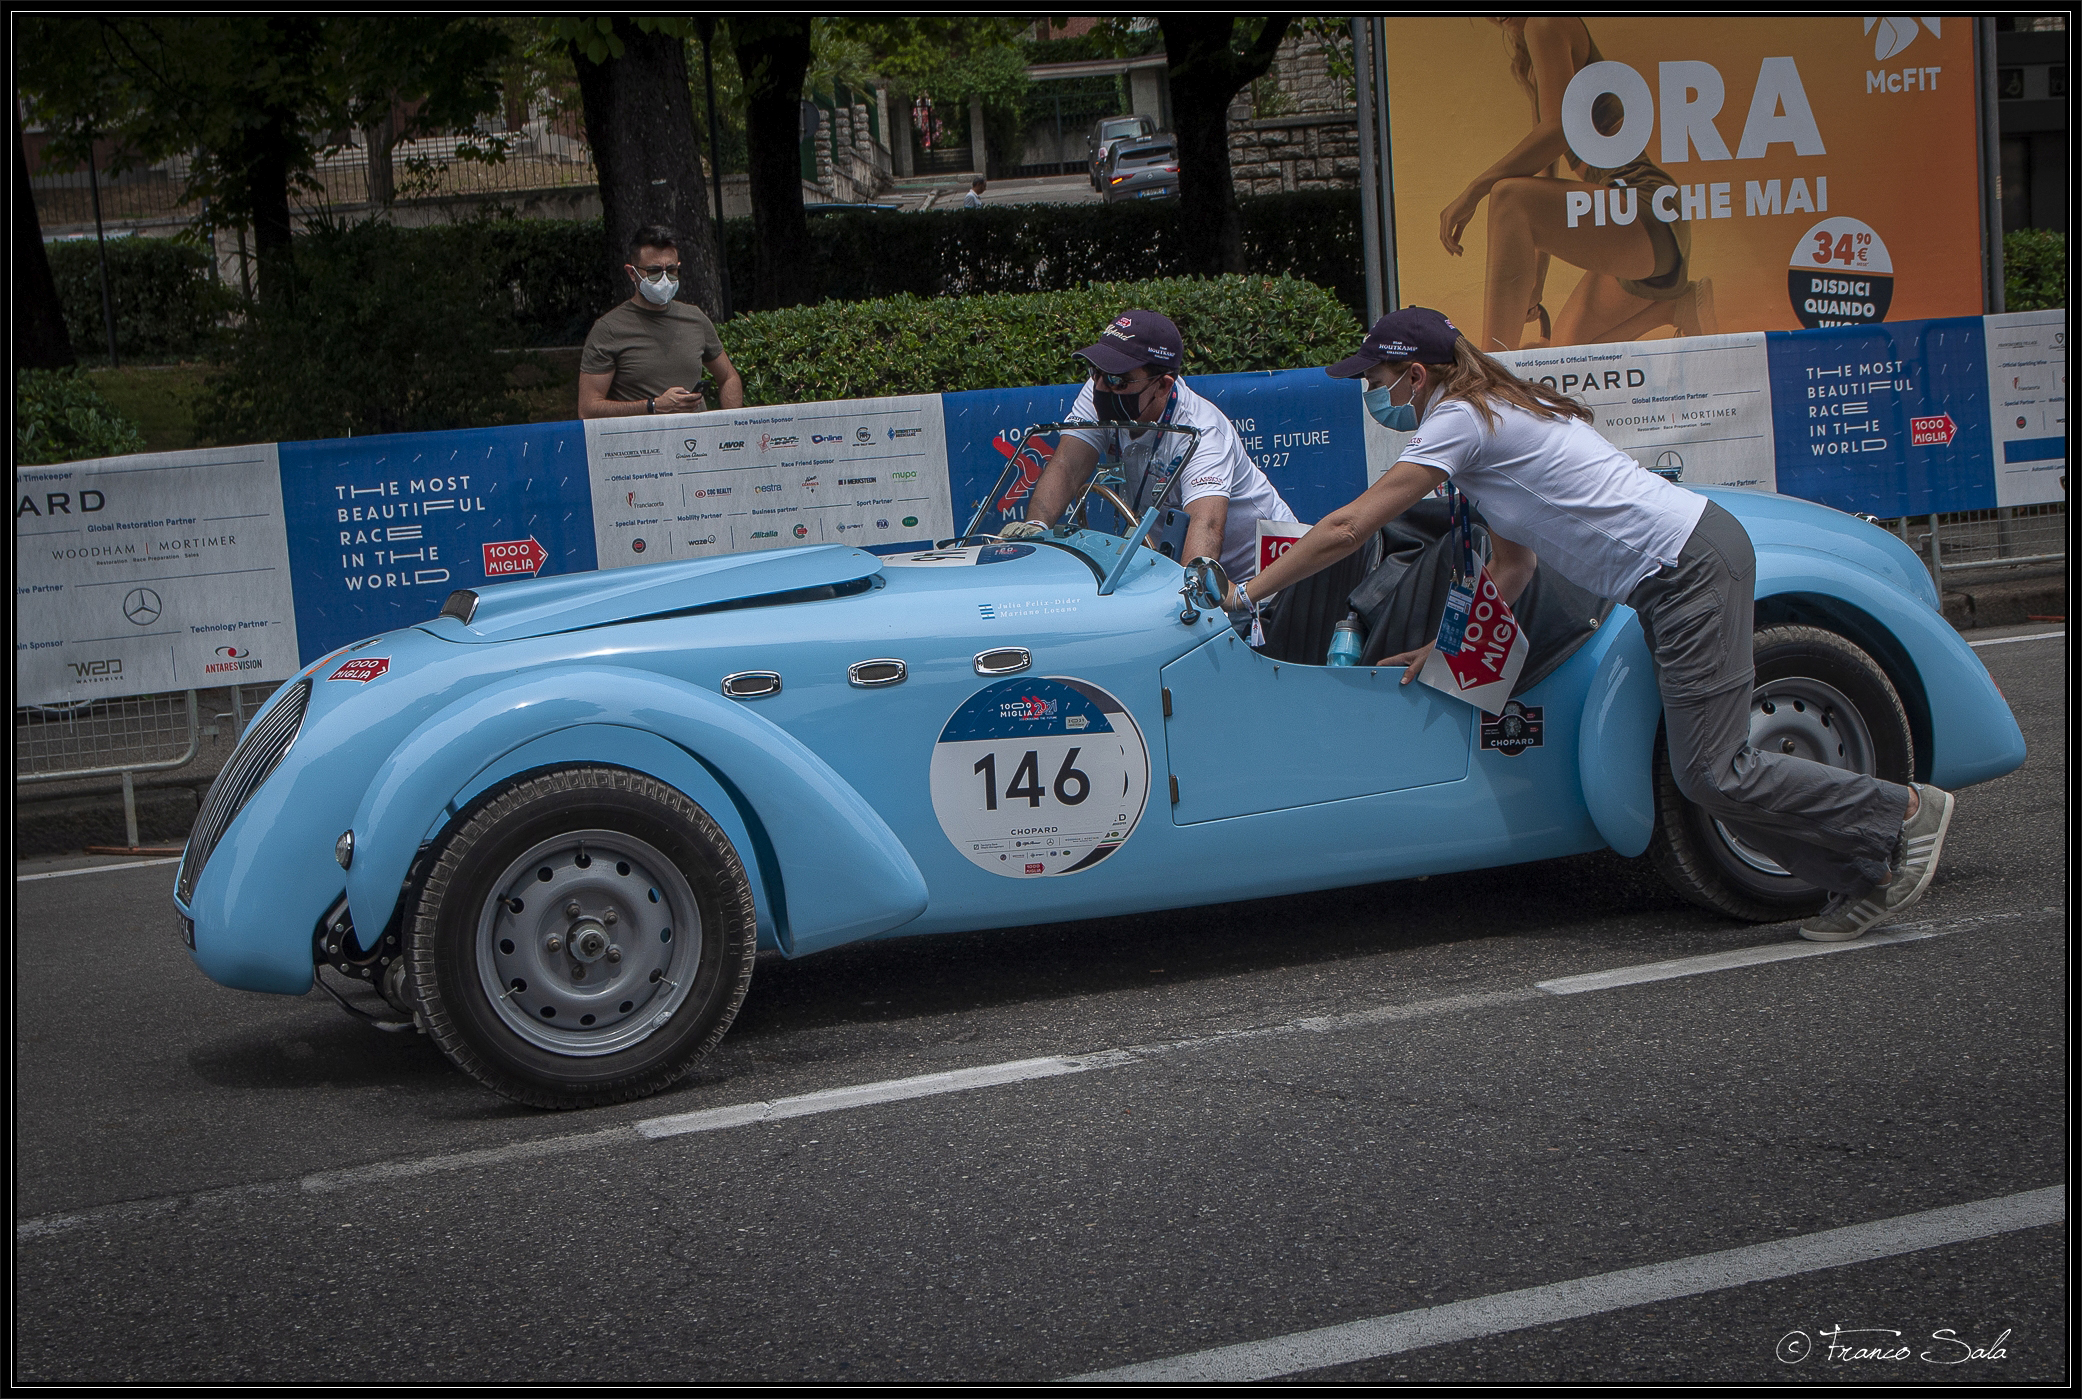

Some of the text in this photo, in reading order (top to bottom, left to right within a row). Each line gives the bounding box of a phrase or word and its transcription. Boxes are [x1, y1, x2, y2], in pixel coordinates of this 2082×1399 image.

[1867, 67, 1941, 94] McFIT
[1561, 56, 1826, 168] ORA
[1566, 176, 1828, 228] PIÙ CHE MAI
[1812, 231, 1855, 266] 34
[1856, 232, 1872, 245] 90
[1811, 278, 1870, 297] DISDICI
[1804, 298, 1875, 318] QUANDO
[1379, 343, 1418, 352] HOUTKAMP
[1534, 359, 1559, 367] Sponsor
[1566, 356, 1587, 364] Official
[1588, 354, 1623, 362] Timekeeper
[1806, 360, 1903, 380] THE MOST
[1807, 379, 1914, 399] BEAUTIFUL
[1632, 392, 1709, 404] Global Restoration Partner
[1605, 407, 1737, 427] WOODHAM MORTIMER
[1809, 401, 1868, 418] RACE
[1810, 420, 1880, 438] IN THE
[1915, 419, 1944, 430] 1000
[719, 440, 745, 449] LAVOR
[1273, 430, 1330, 448] FUTURE
[1914, 431, 1947, 443] MIGLIA
[1811, 438, 1887, 456] WORLD
[1253, 452, 1290, 468] 1927
[23, 472, 72, 482] Timekeeper
[611, 473, 631, 482] Official
[632, 472, 658, 481] Sparkling
[1736, 478, 1758, 487] Partner
[335, 475, 470, 500] THE MOST
[761, 483, 782, 493] estra
[17, 489, 105, 518] ARD
[337, 497, 486, 522] BEAUTIFUL
[752, 507, 776, 515] Business
[87, 517, 196, 533] Global Restoration Partner
[636, 518, 658, 526] Partner
[677, 515, 700, 523] Mobility
[340, 524, 423, 545] RACE
[688, 538, 708, 546] waze
[750, 530, 778, 539] Alitalia
[52, 535, 237, 560] WOODHAM MORTIMER
[489, 544, 530, 558] 1000
[342, 546, 439, 568] IN THE
[488, 558, 534, 573] MIGLIA
[345, 568, 450, 590] WORLD
[32, 585, 64, 593] Partner
[1000, 606, 1077, 618] Mariano Lozano
[1460, 580, 1498, 653] 1000
[190, 619, 268, 634] Technology Partner
[29, 640, 64, 651] Sponsor
[205, 659, 263, 674] ANTARESVISION
[346, 660, 379, 668] 1000
[332, 669, 371, 679] MIGLIA
[1000, 702, 1032, 710] 1000
[1000, 710, 1033, 718] MIGLIA
[1490, 738, 1534, 747] CHOPARD
[973, 746, 1091, 811] 146
[1010, 826, 1058, 835] CHOPARD
